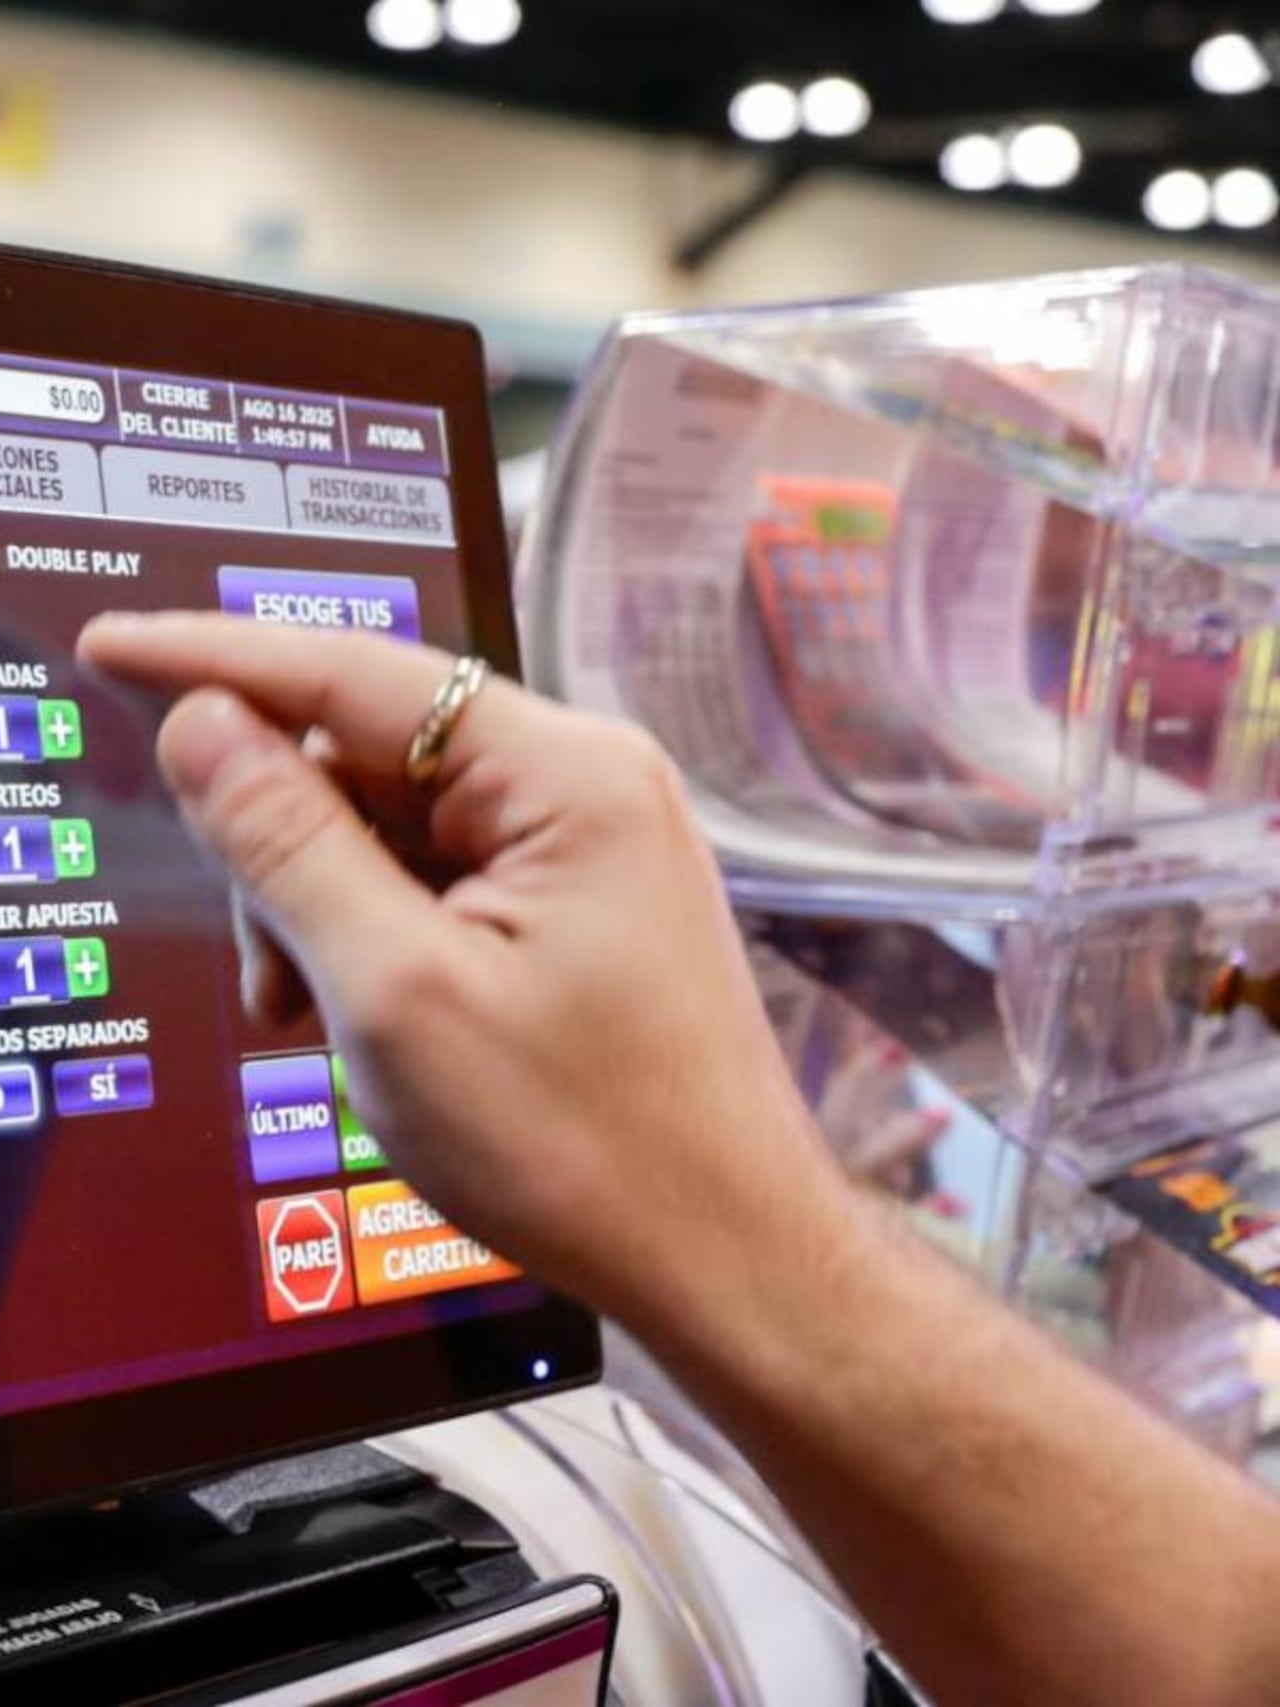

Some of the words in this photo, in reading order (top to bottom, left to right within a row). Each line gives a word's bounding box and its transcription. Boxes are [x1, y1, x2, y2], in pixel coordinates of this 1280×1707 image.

[49, 384, 101, 414] $0.00
[141, 381, 210, 411] CIERRE
[121, 411, 157, 437] DEL
[160, 414, 237, 445] CLIENTE
[243, 398, 273, 420] AGO
[279, 403, 296, 422] 16
[299, 405, 334, 427] 2025
[252, 426, 306, 448] 1:49:57
[309, 430, 332, 451] PM
[366, 424, 424, 451] AYUDA
[148, 474, 245, 503] REPORTES
[309, 477, 402, 506] HISTORIAL
[407, 486, 426, 507] DE
[302, 501, 442, 533] TRANSACCIONES
[7, 545, 88, 572] DOUBLE
[93, 550, 141, 576] PLAY
[253, 593, 344, 625] ESCOGE
[347, 597, 393, 627] TUS
[3, 825, 23, 871] 1
[27, 900, 118, 928] APUESTA
[16, 947, 36, 992] 1
[28, 1018, 149, 1051] SEPARADOS
[251, 1102, 330, 1136] ÚLTIMO
[343, 1134, 382, 1160] CO
[358, 1198, 447, 1238] AGREG
[276, 1239, 335, 1275] PARE
[8, 1598, 101, 1630] JUGADAS
[59, 1609, 123, 1636] ABAJO
